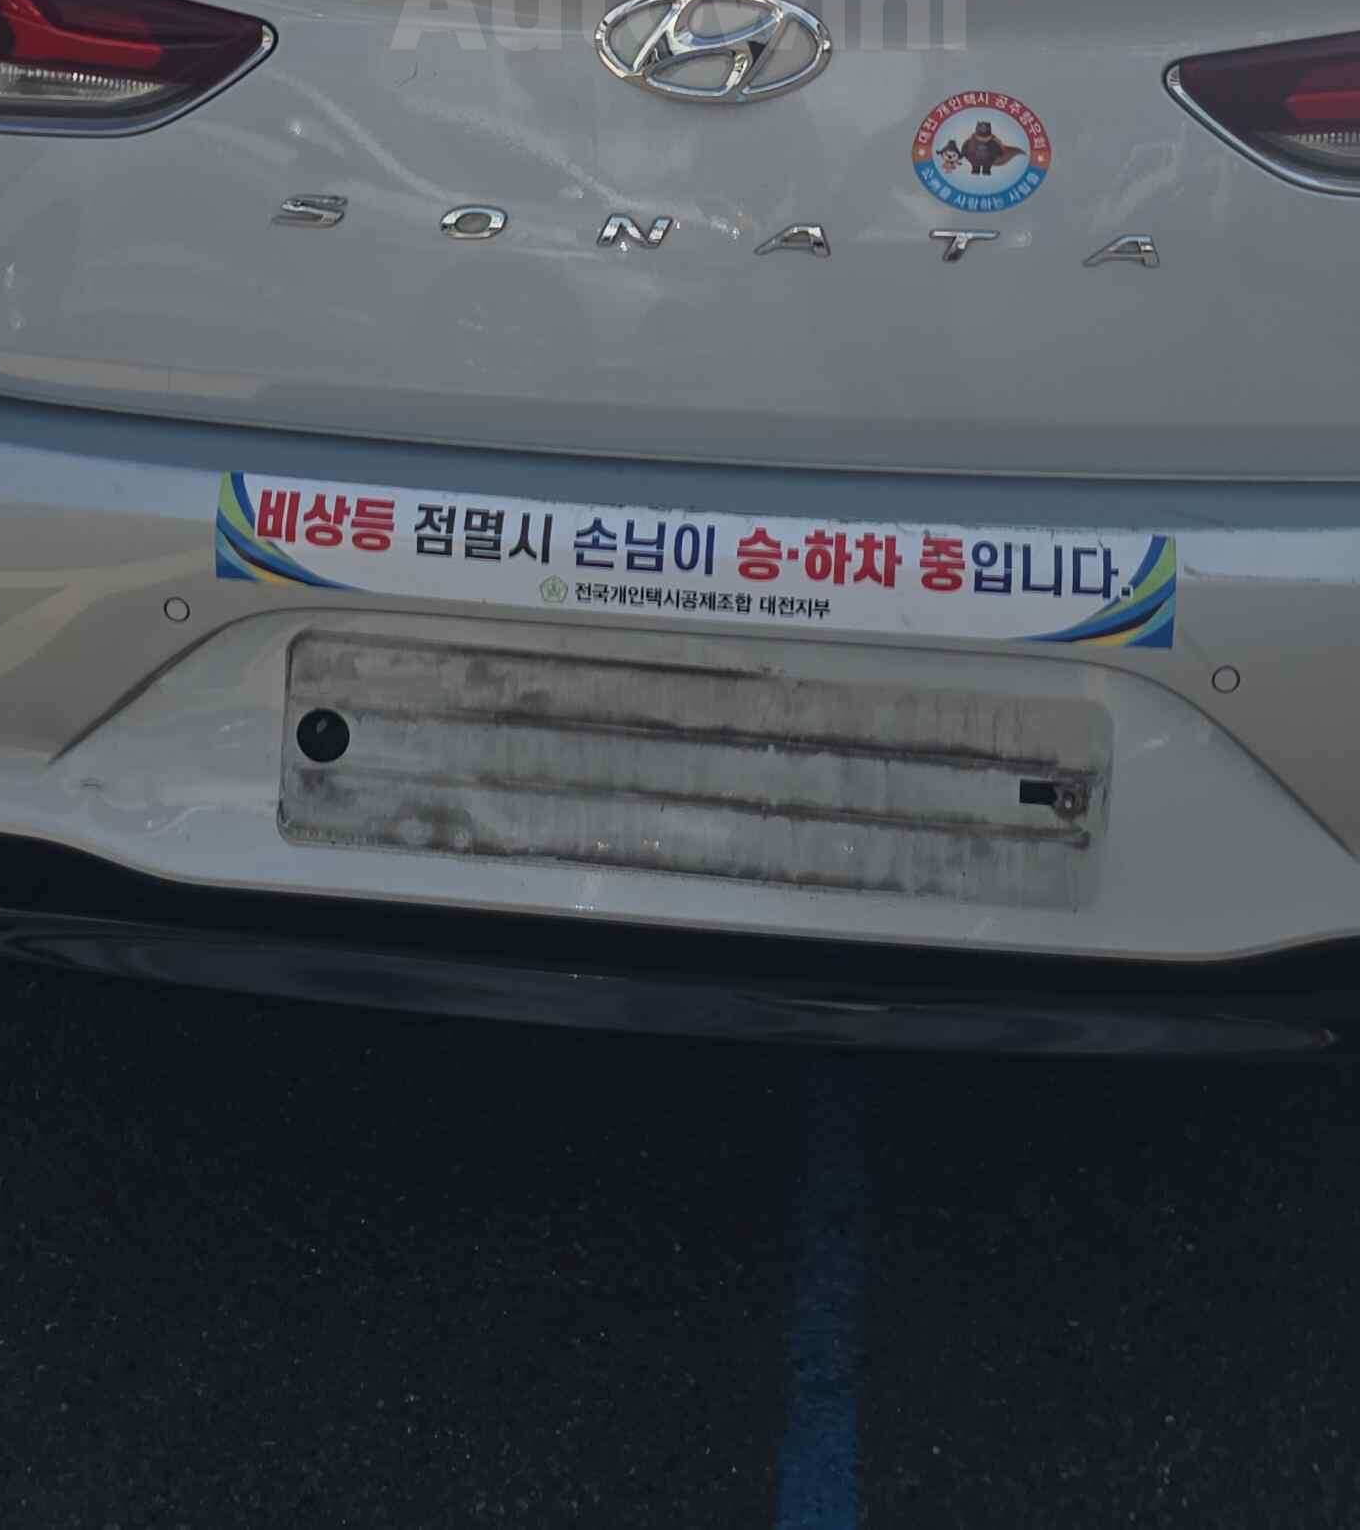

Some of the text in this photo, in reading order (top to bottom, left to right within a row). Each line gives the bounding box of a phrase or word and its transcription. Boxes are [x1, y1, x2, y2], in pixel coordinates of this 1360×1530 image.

[271, 193, 1161, 269] SONATA
[254, 488, 396, 552] 비상등
[414, 503, 553, 565] 점멸시
[573, 517, 716, 577] 손님이
[575, 582, 832, 619] 전국개인택시공제조합 대전지부
